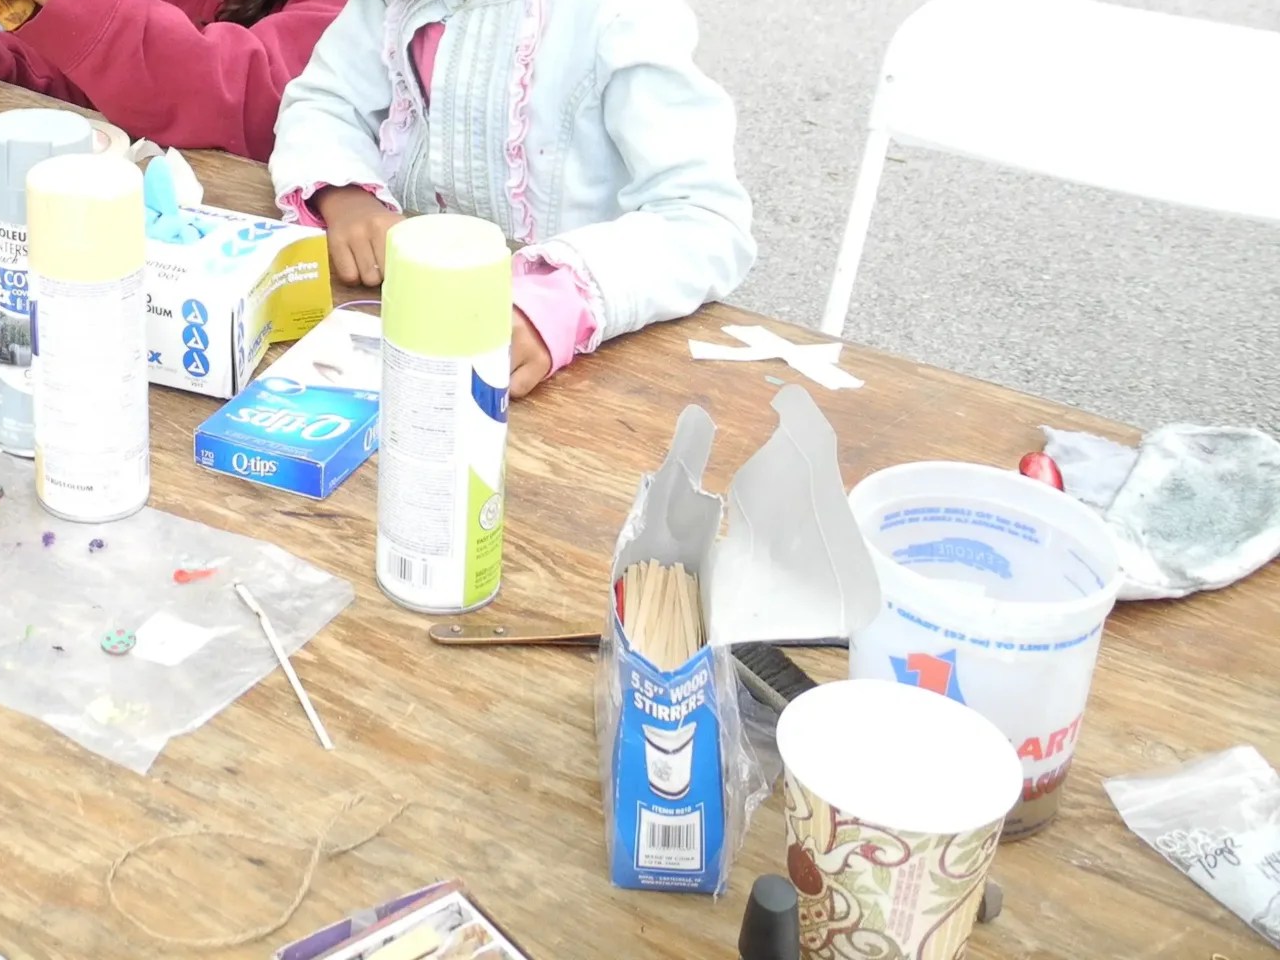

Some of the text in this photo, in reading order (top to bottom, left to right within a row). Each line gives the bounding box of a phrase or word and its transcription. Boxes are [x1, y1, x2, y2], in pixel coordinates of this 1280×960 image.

[225, 406, 354, 442] Q-tips
[200, 449, 215, 459] 170
[231, 452, 280, 478] Q-tips
[50, 478, 95, 492] RUST-OLEUM
[896, 607, 941, 633] QUART
[995, 641, 1016, 651] TO
[1019, 642, 1051, 652] LINE
[670, 668, 708, 704] WOOD
[633, 689, 705, 722] STIRRERS
